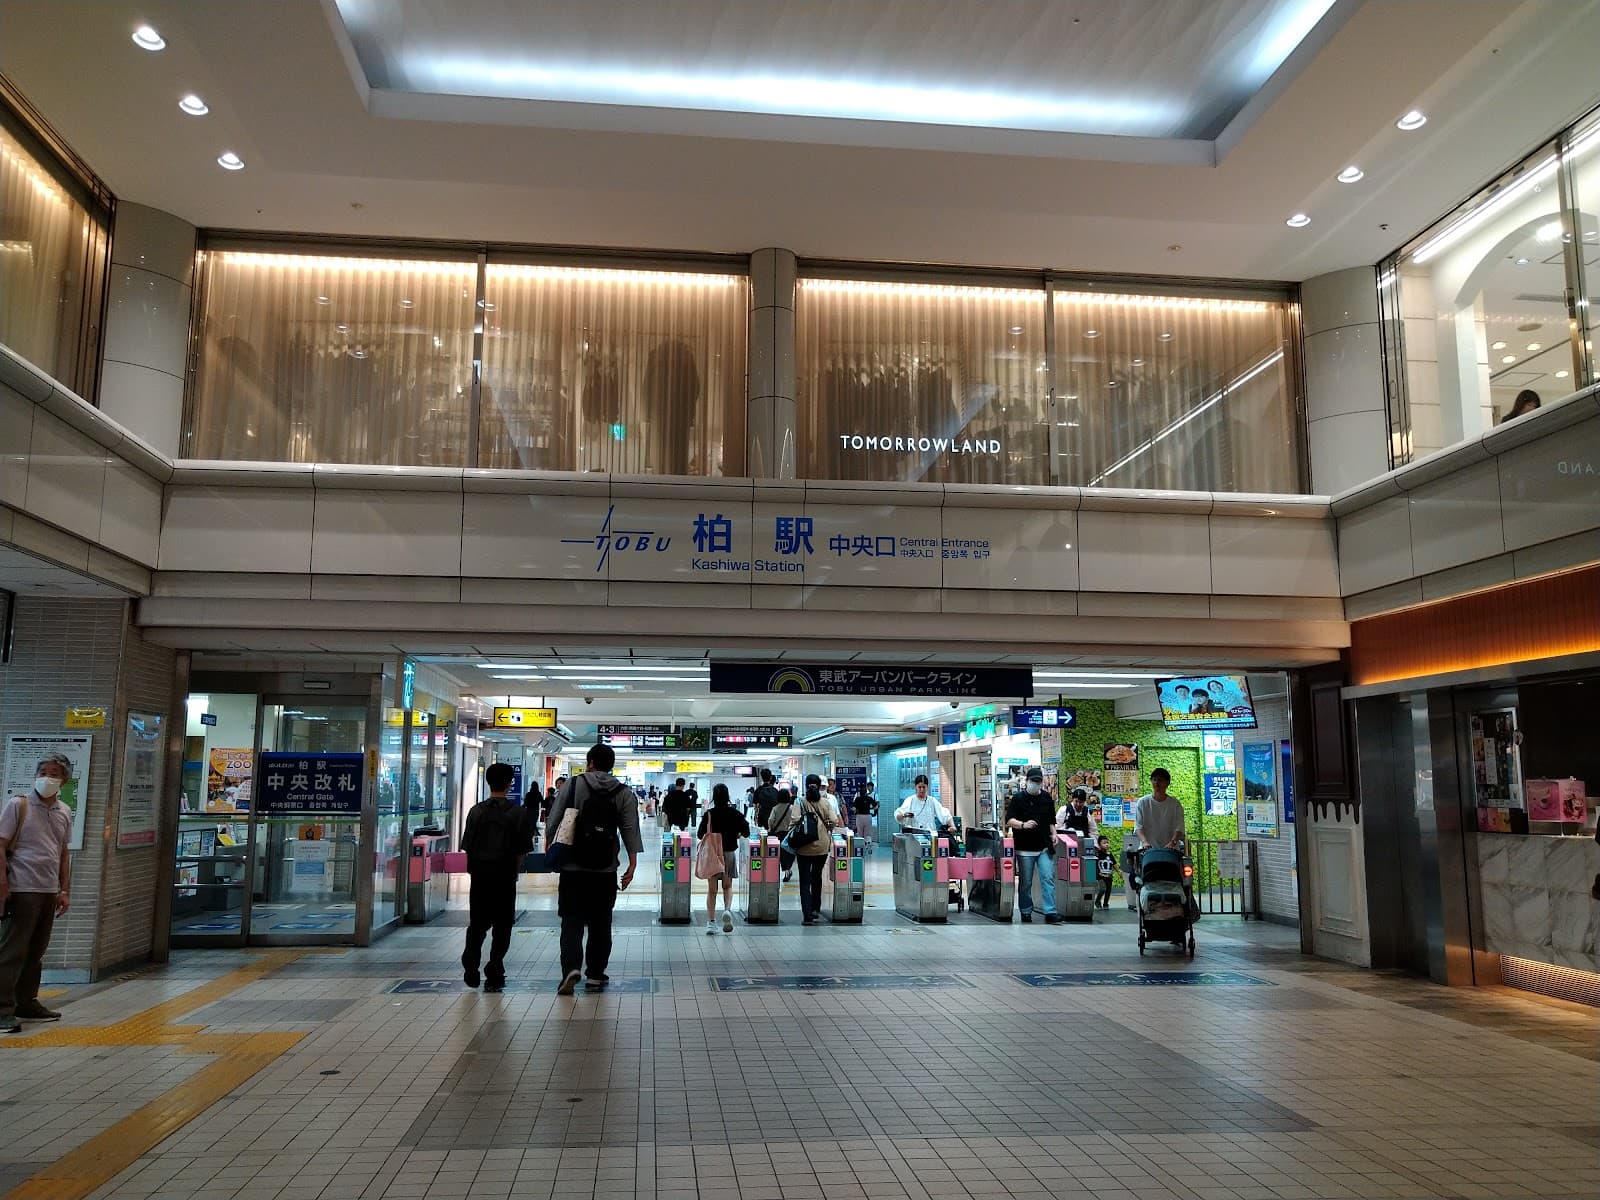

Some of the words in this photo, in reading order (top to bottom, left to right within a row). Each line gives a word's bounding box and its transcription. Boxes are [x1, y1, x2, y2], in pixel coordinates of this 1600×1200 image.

[840, 435, 1001, 454] TOMORROWLAND
[829, 534, 896, 557] 中央口
[900, 537, 938, 547] Central
[941, 538, 989, 548] Entrance
[900, 549, 933, 558] 中央入口
[692, 558, 749, 571] Kashiwa
[754, 559, 804, 572] Station
[819, 669, 977, 685] 東武アーバンパークライン
[820, 685, 853, 693] TOBU
[949, 687, 977, 695] LINE
[227, 760, 252, 769] ZOO
[267, 772, 356, 792] 中央改札
[286, 793, 314, 801] Central
[316, 793, 334, 801] Gate
